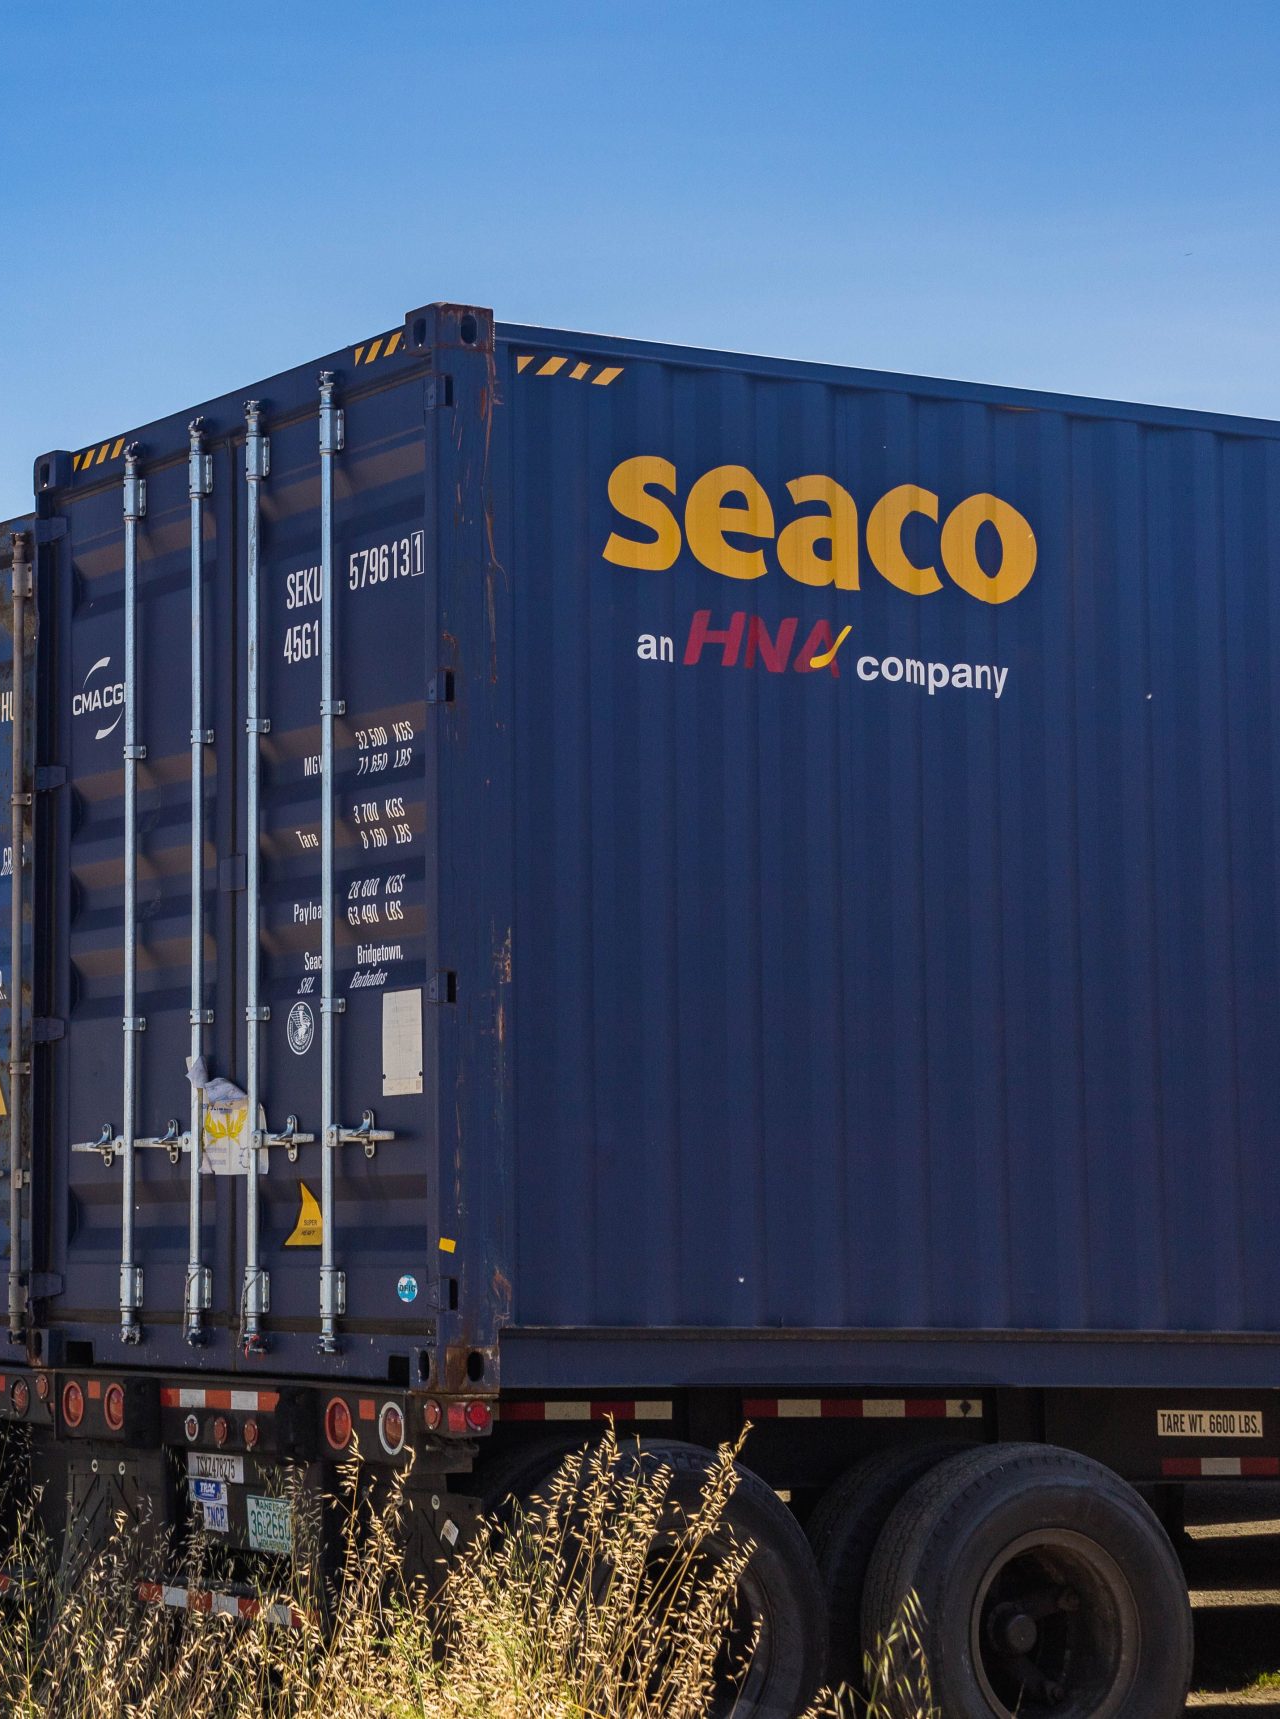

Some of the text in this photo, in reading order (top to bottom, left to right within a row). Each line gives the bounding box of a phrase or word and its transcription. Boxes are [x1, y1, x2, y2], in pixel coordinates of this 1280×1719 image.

[602, 456, 1037, 604] seaco
[286, 533, 423, 610] SEKU 5796131
[283, 620, 319, 664] 45G1
[636, 609, 1008, 698] an HNA company
[104, 682, 126, 708] CG
[392, 721, 414, 742] KGS
[393, 748, 412, 769] LBS
[385, 797, 405, 819] KGS
[296, 830, 319, 849] Tare
[393, 823, 412, 845] LBS
[385, 873, 406, 895] KGS
[293, 902, 323, 926] Payloa
[385, 900, 404, 921] LBS
[304, 944, 404, 971] Seac Bridgetown,
[350, 968, 388, 989] Barbados
[303, 1219, 318, 1227] SUPER
[1160, 1413, 1261, 1434] TARE WT. 6600 LBS.
[200, 1482, 216, 1493] TRAC
